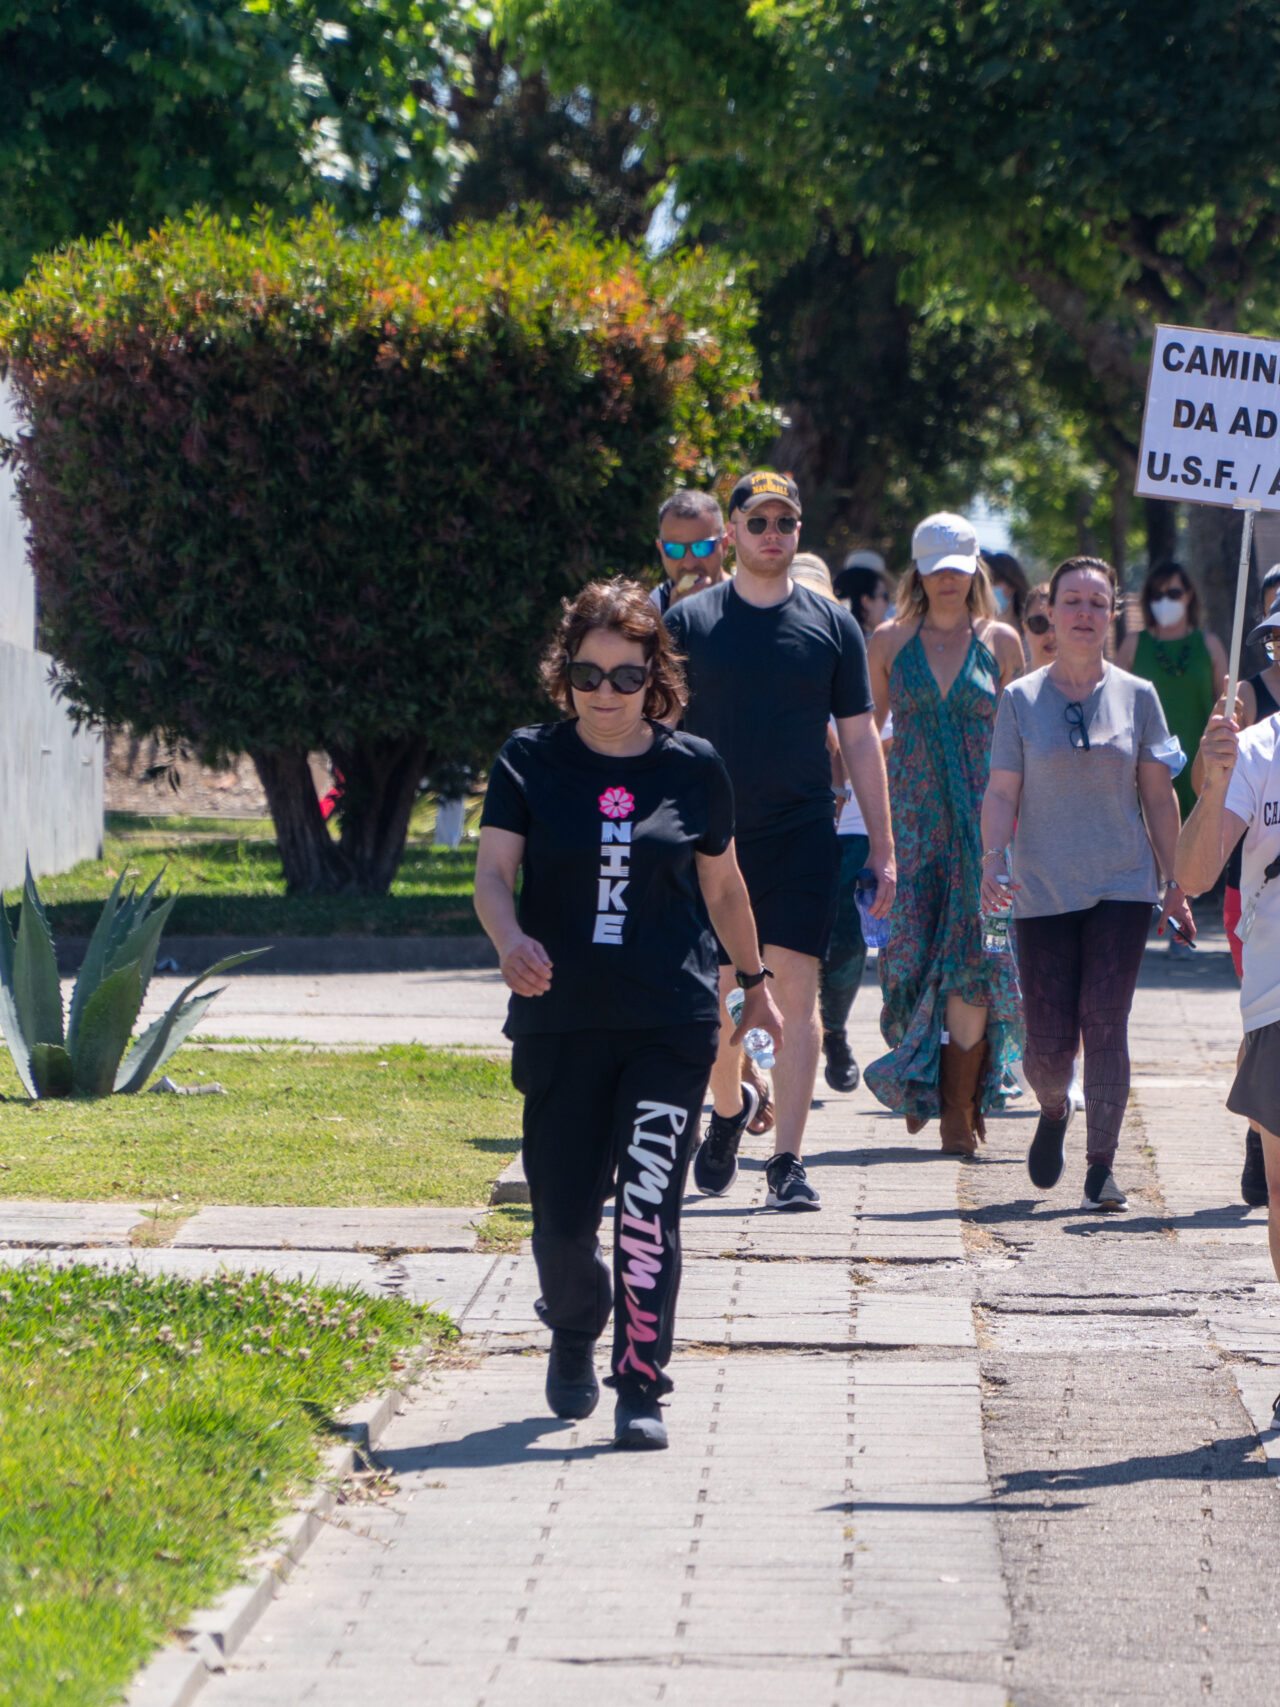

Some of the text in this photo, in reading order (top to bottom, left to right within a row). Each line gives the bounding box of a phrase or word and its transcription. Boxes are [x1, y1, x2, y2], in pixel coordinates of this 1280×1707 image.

[1172, 398, 1218, 433] DA
[1146, 450, 1238, 491] U.S.F.
[592, 821, 633, 945] NIKE
